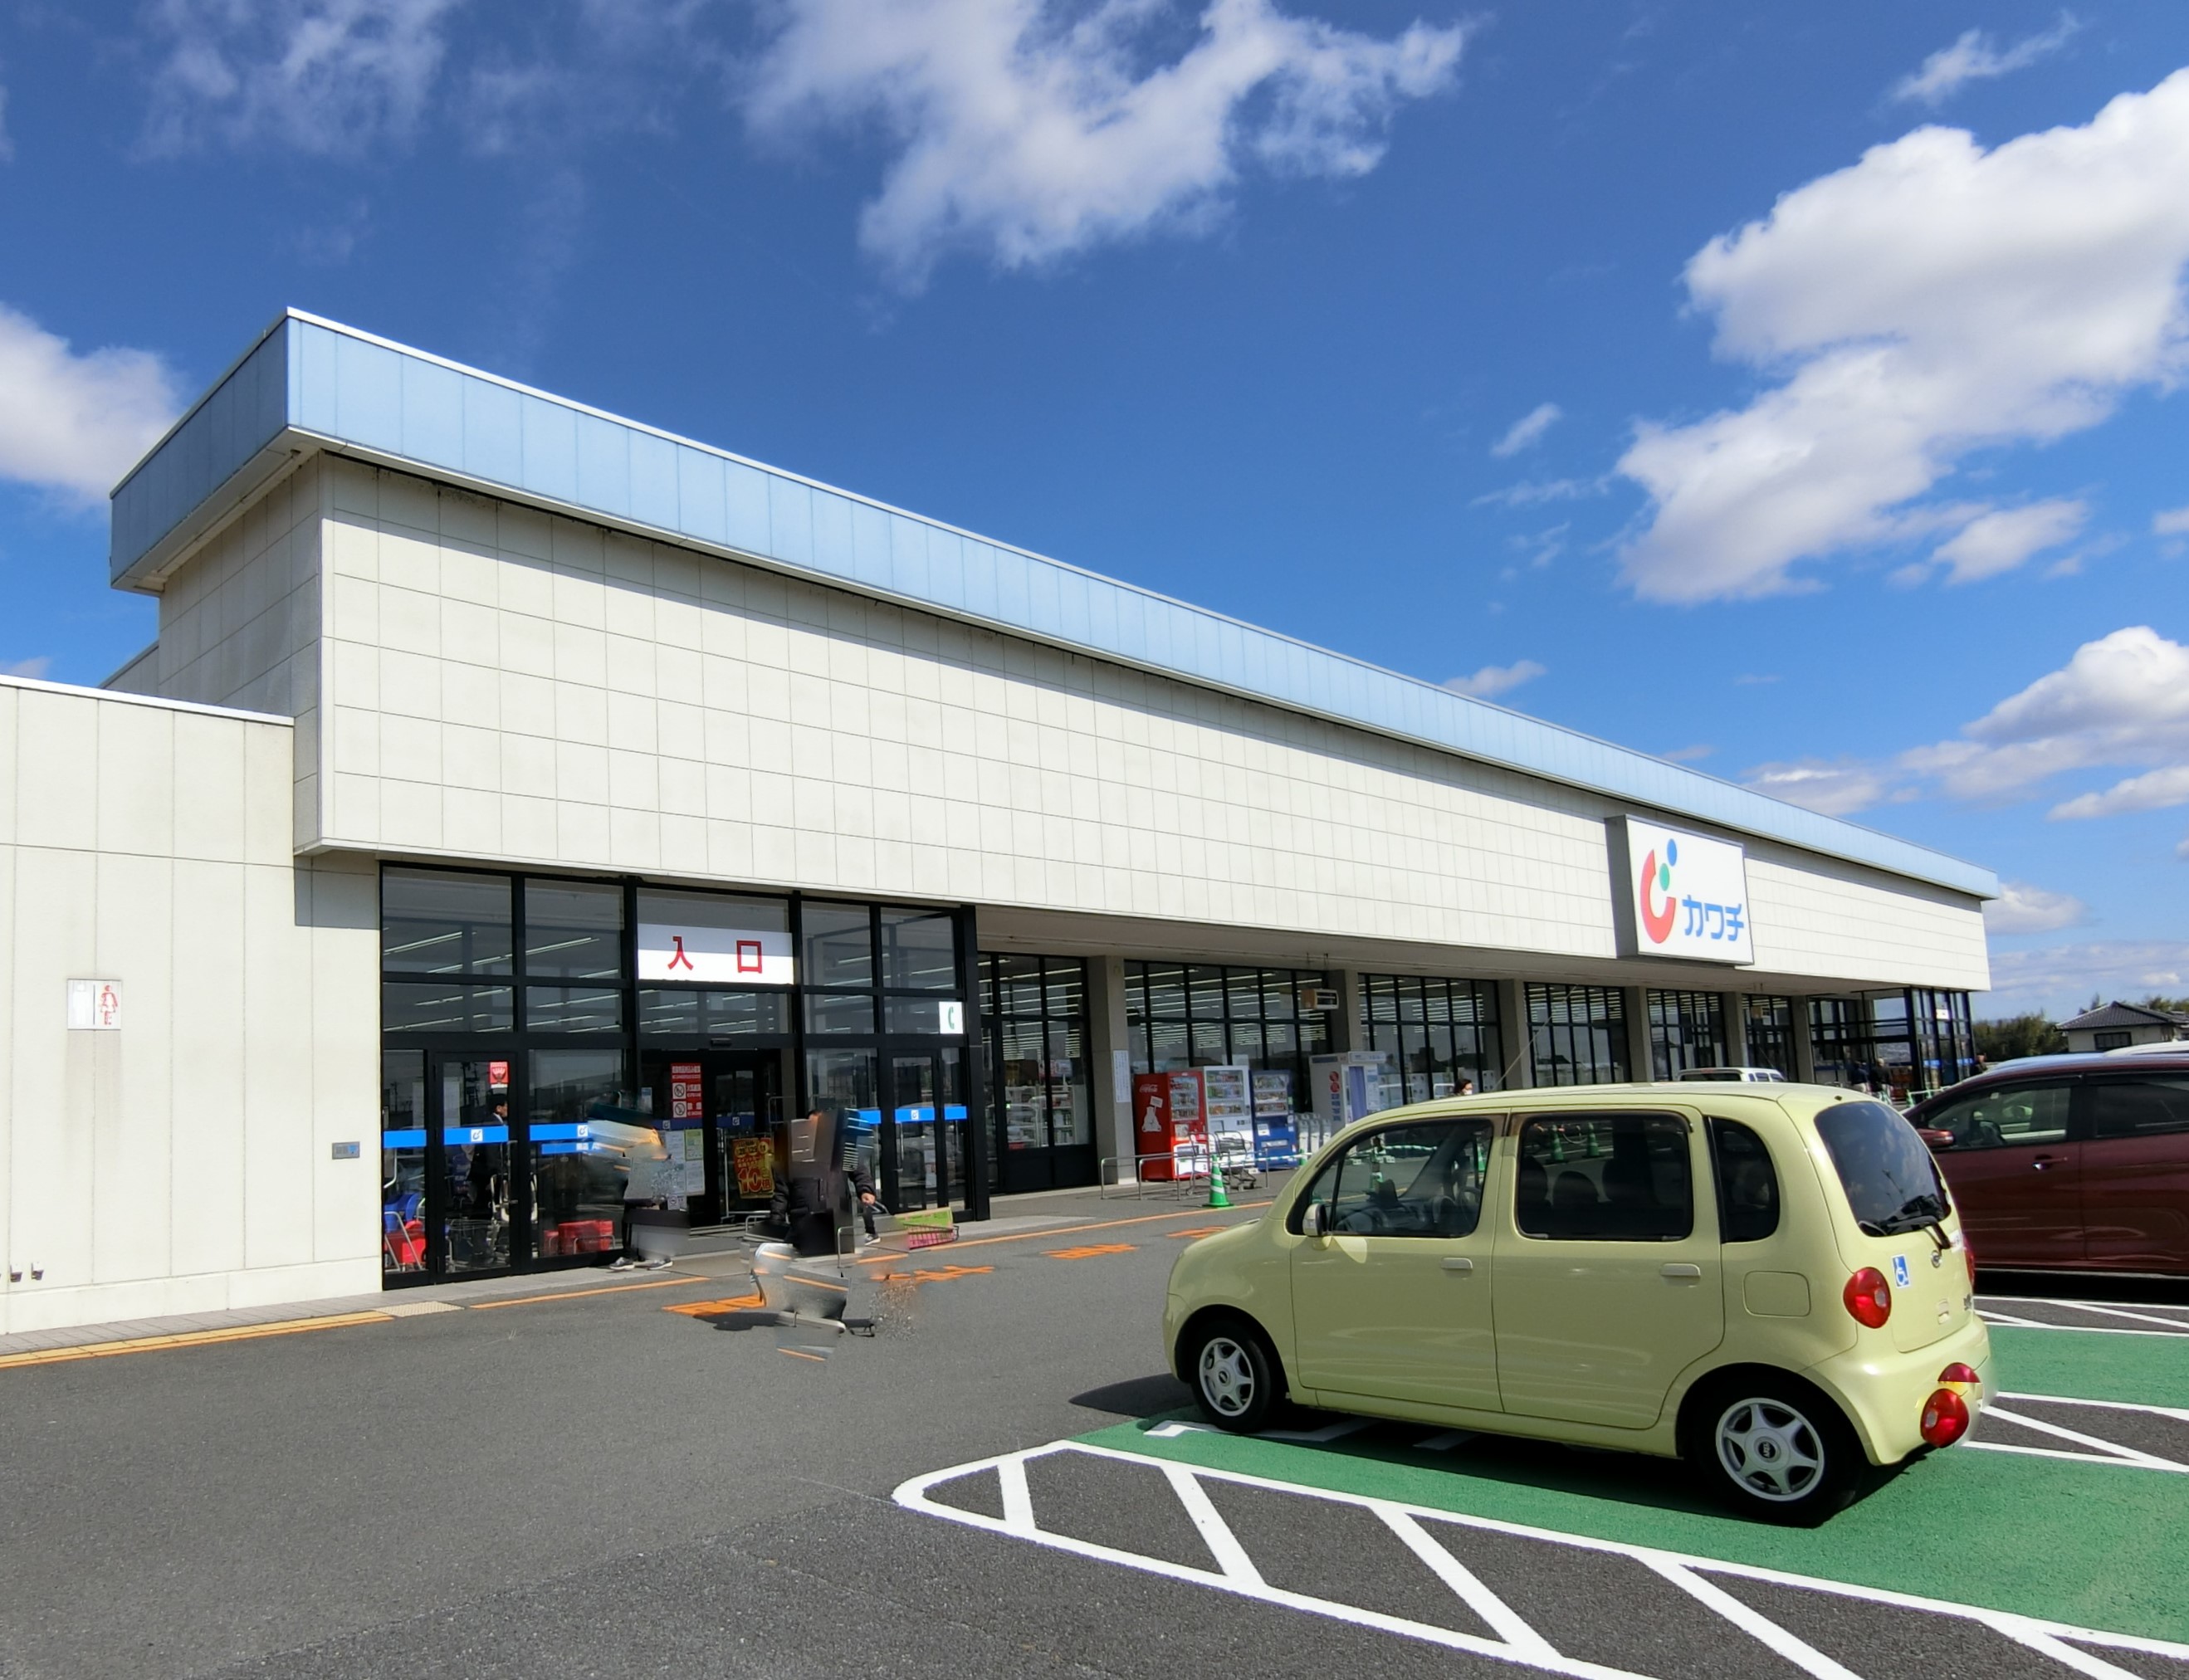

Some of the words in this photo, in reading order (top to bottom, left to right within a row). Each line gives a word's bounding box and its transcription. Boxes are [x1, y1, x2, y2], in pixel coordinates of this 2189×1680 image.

[1682, 895, 1745, 941] カワチ
[667, 935, 763, 974] 入口
